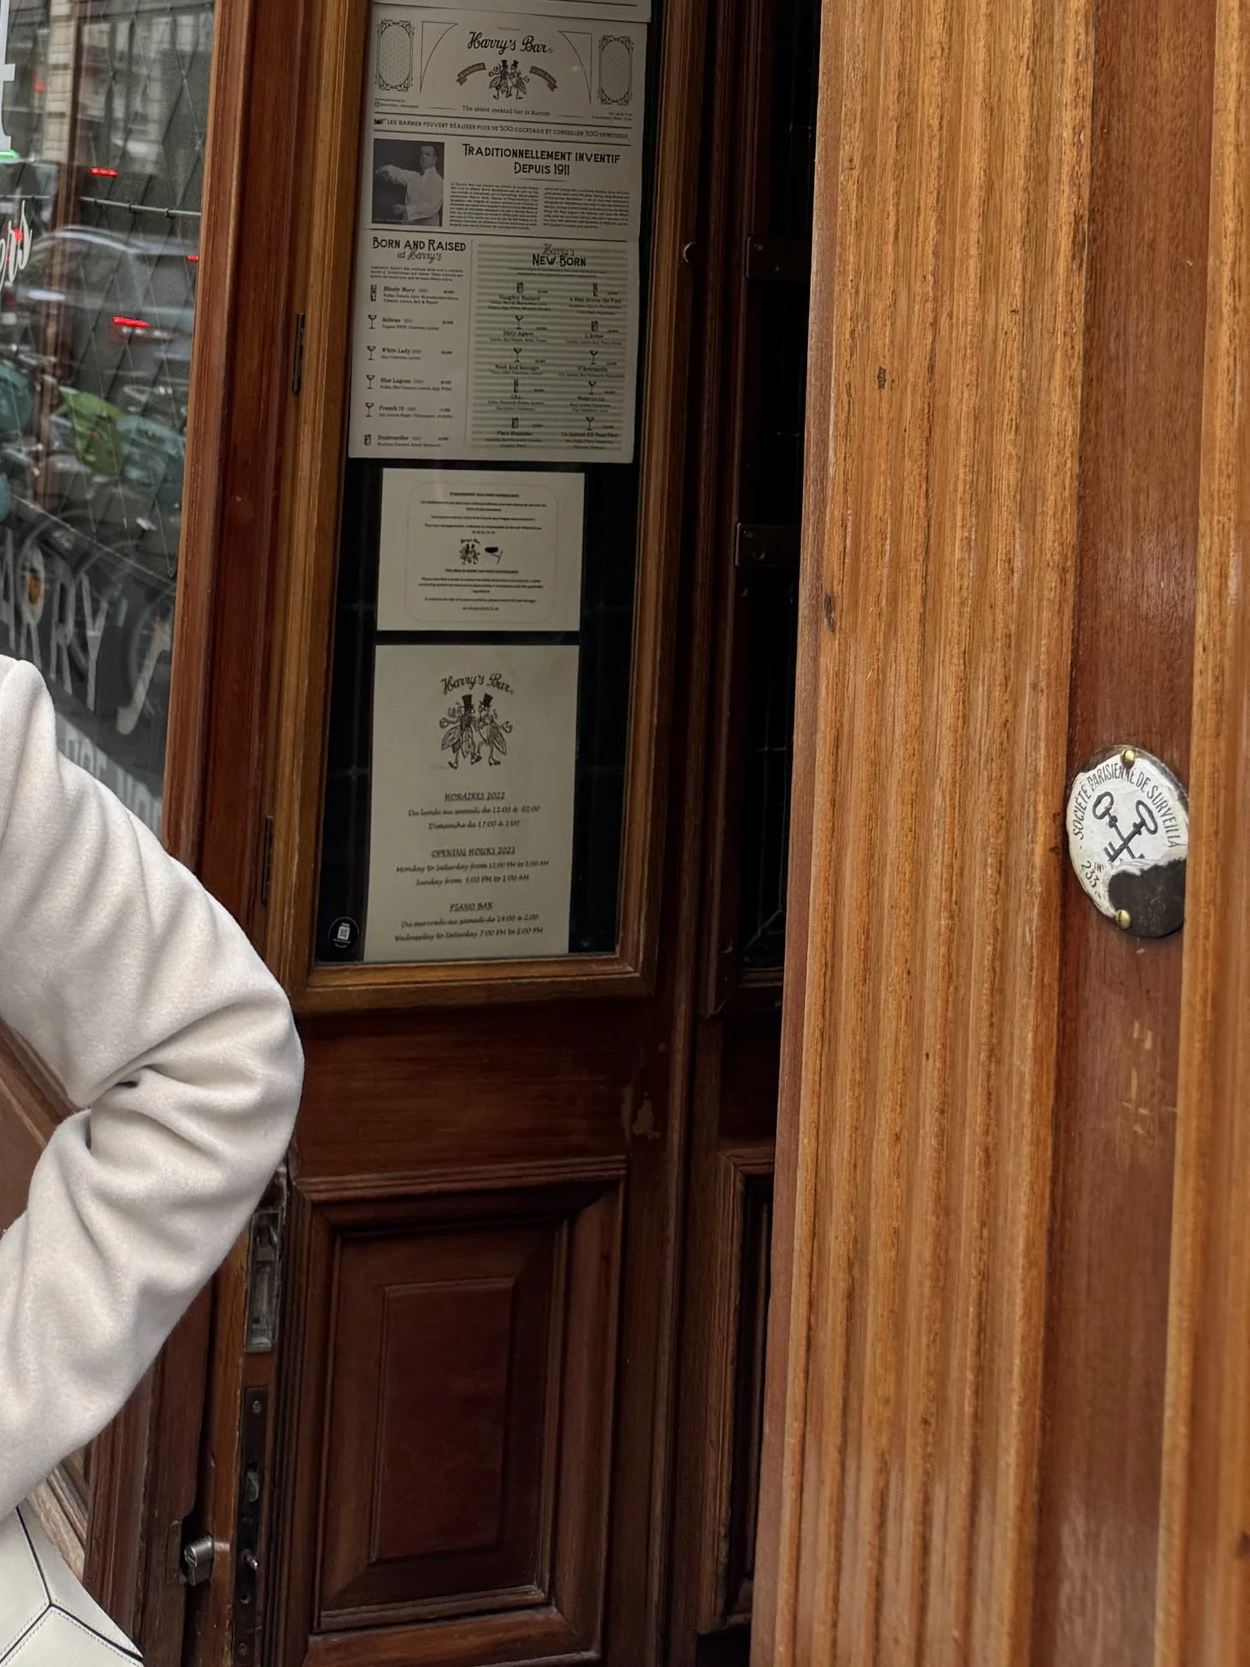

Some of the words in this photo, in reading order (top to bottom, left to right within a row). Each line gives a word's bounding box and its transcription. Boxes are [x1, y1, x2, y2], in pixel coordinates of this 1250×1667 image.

[466, 31, 516, 56] Harry's
[520, 35, 549, 54] Bar
[462, 143, 572, 162] TRADITIONNELLEMENT
[575, 151, 621, 165] INVENTIF
[513, 161, 551, 176] DEPUIS
[553, 163, 570, 176] 1911
[372, 236, 400, 249] BORN
[403, 239, 425, 250] AND
[428, 239, 466, 252] RAISED
[407, 249, 443, 264] Harry's
[532, 254, 557, 267] NEW
[559, 254, 587, 267] BORN
[441, 674, 486, 696] Harry's
[487, 672, 510, 693] Bar
[1135, 772, 1151, 793] DE
[444, 792, 484, 802] HORAIRES
[486, 791, 505, 801] 2022
[431, 848, 467, 858] OPENING
[468, 847, 495, 856] HOURS
[497, 846, 516, 855] 2022
[396, 864, 425, 874] Monday
[435, 863, 468, 873] Saturday
[449, 903, 476, 912] PIANO
[477, 902, 493, 910] BAR
